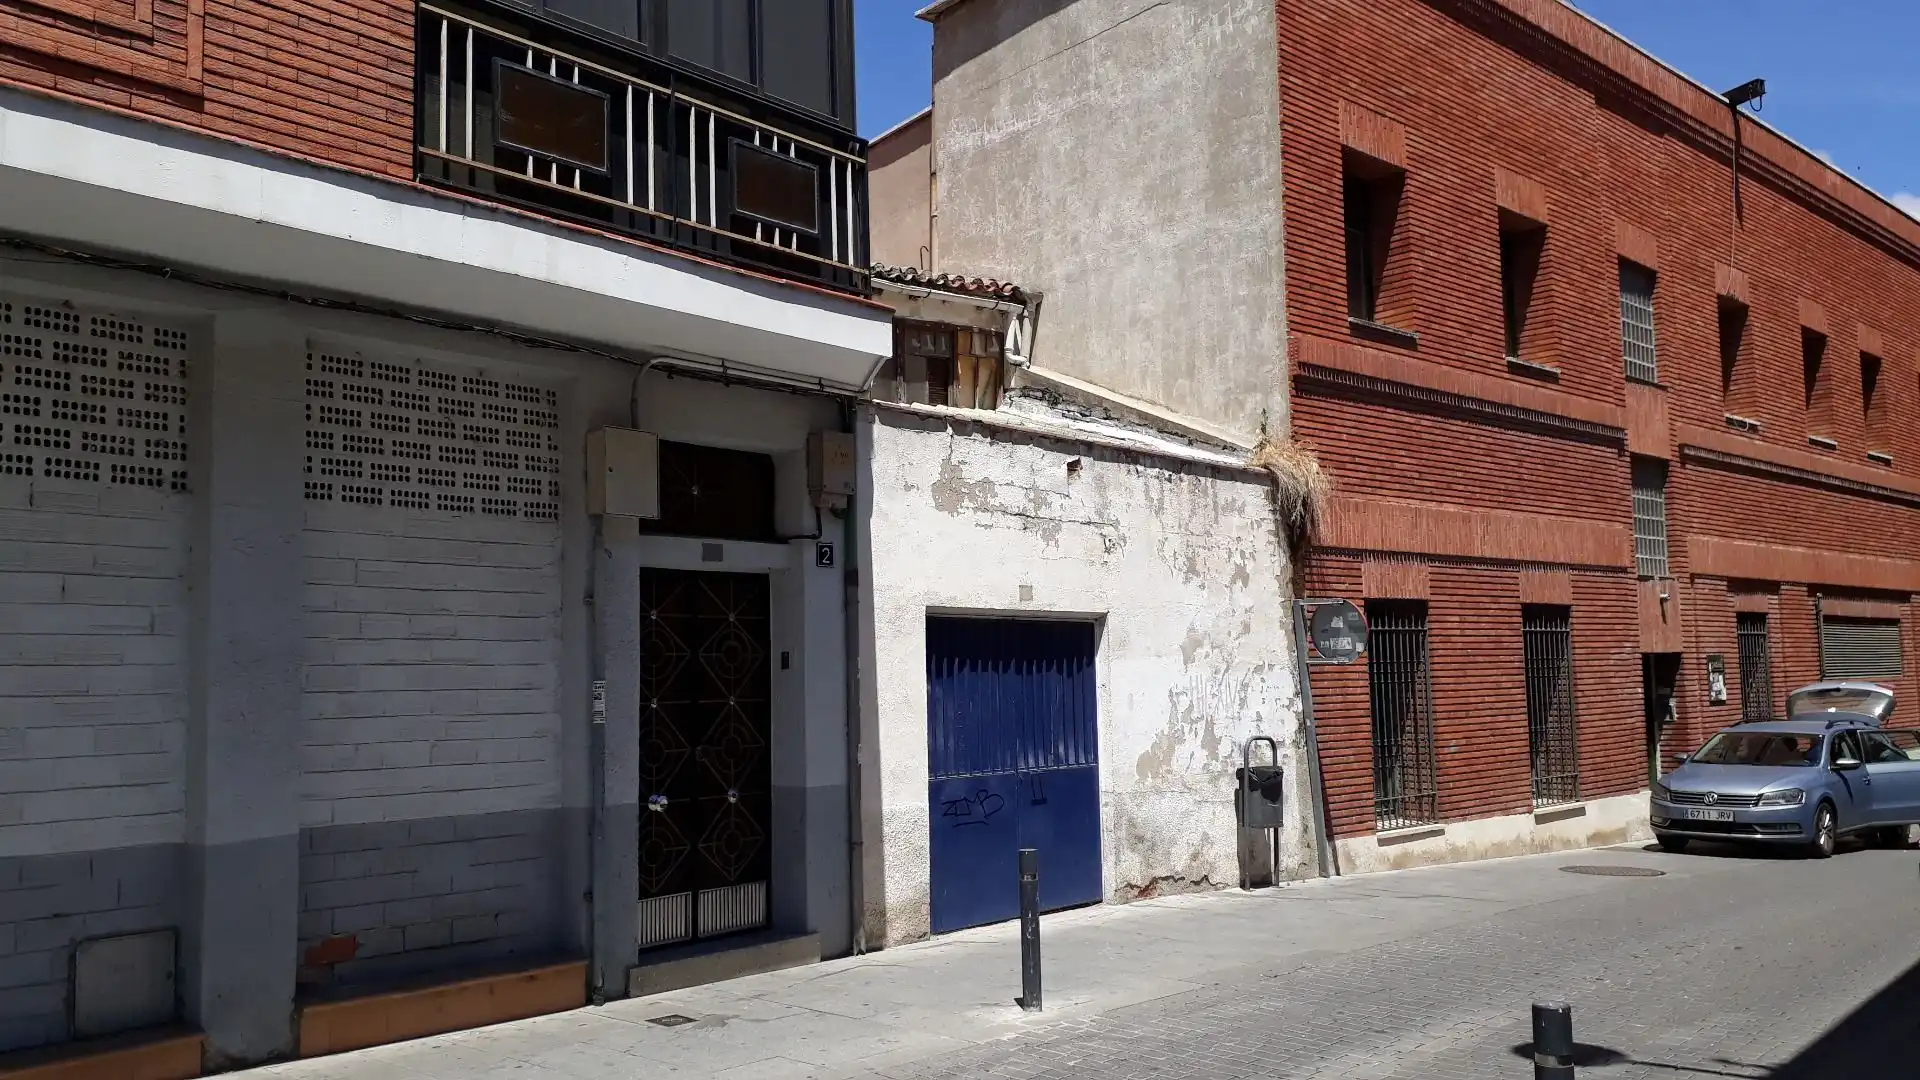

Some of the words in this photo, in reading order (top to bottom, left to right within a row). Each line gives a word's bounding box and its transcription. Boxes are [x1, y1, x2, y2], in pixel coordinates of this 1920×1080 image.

[822, 547, 831, 563] 2
[1690, 810, 1711, 819] 6711
[1715, 811, 1732, 820] JRV
